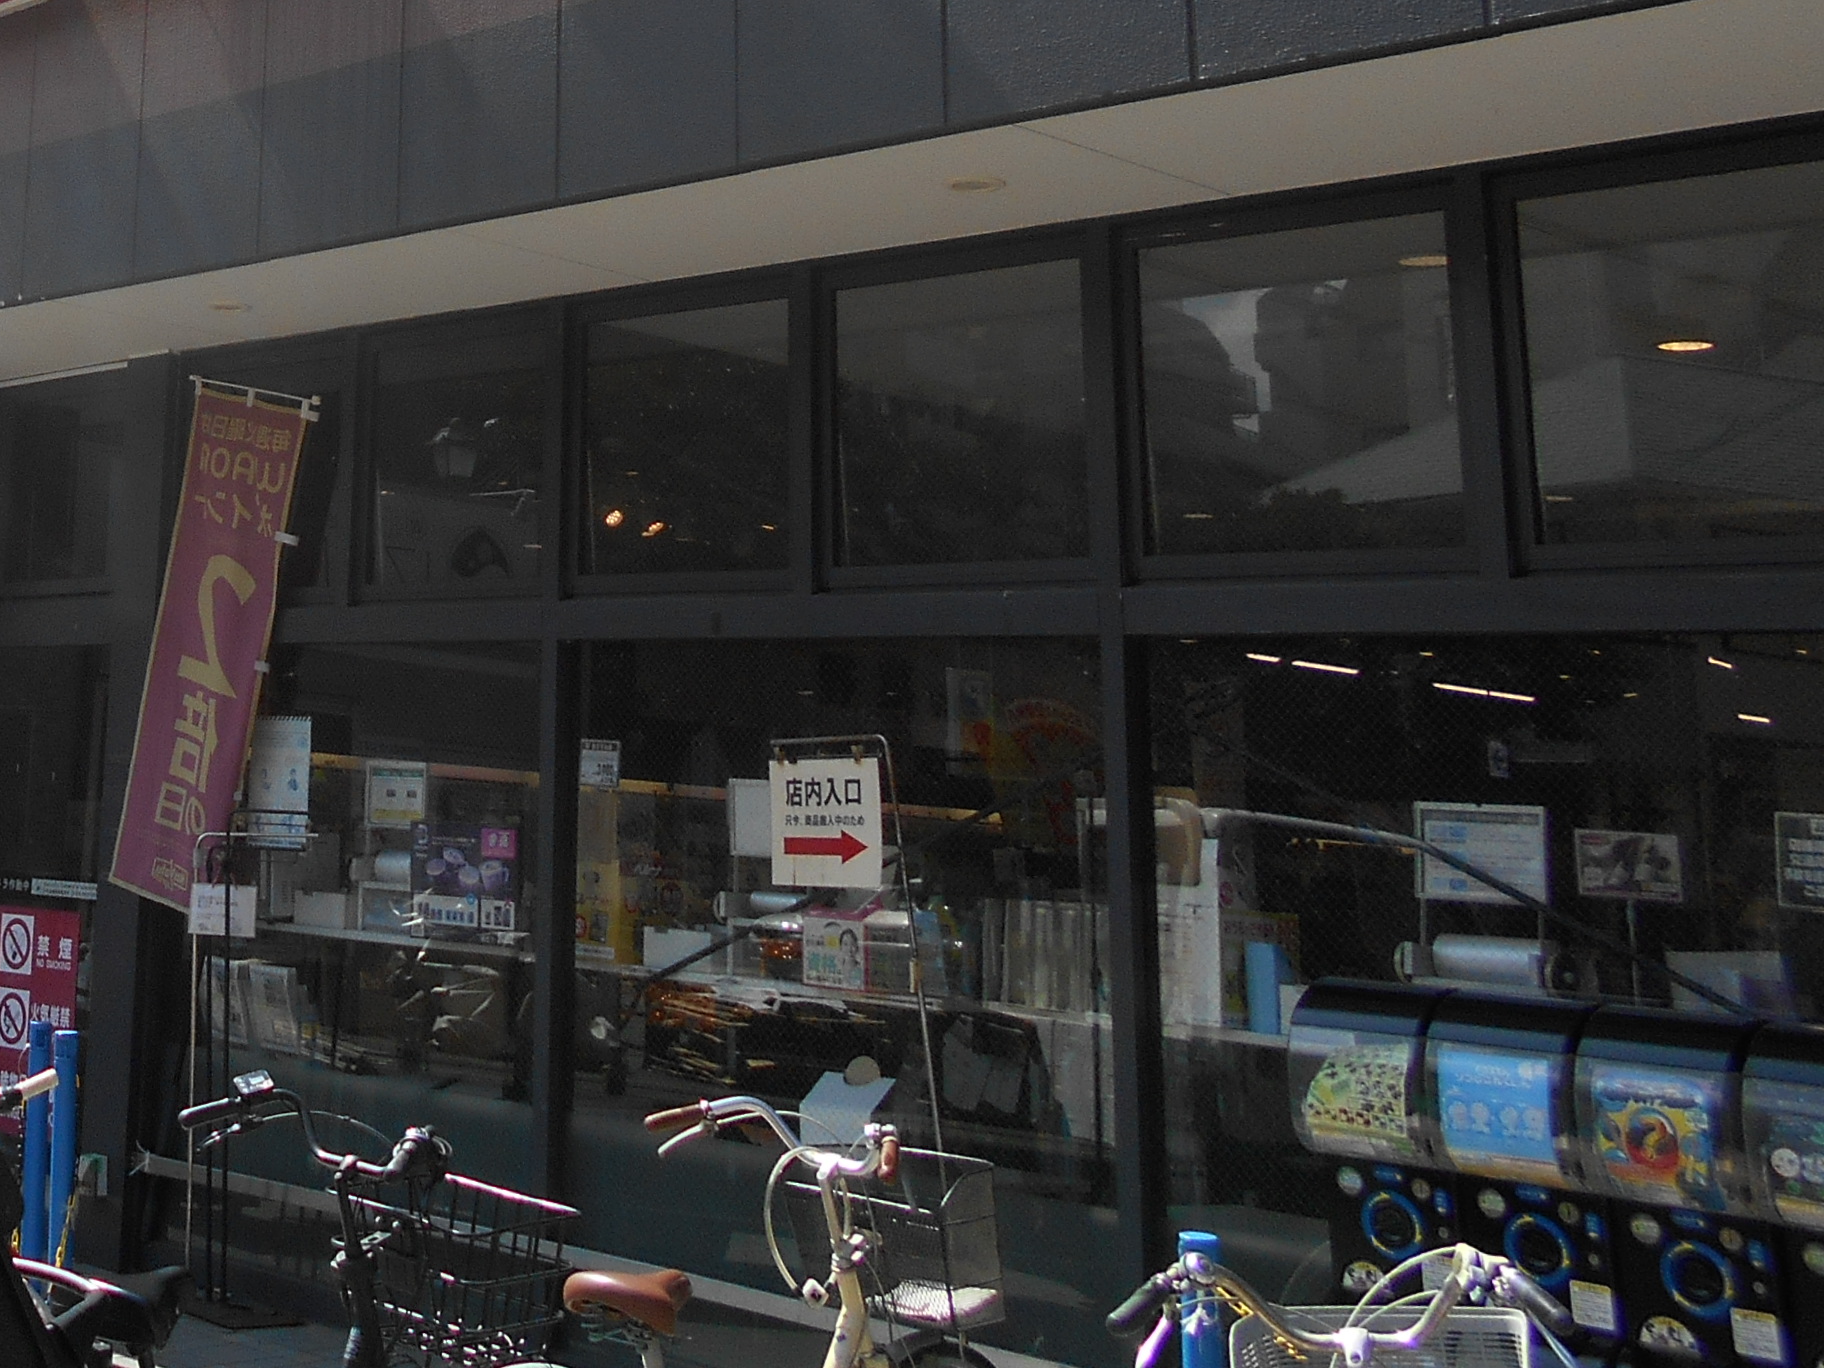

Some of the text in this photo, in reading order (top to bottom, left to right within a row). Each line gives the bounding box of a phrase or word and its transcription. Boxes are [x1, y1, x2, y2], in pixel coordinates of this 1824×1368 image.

[785, 777, 862, 807] 店内入口
[35, 958, 45, 969] NO
